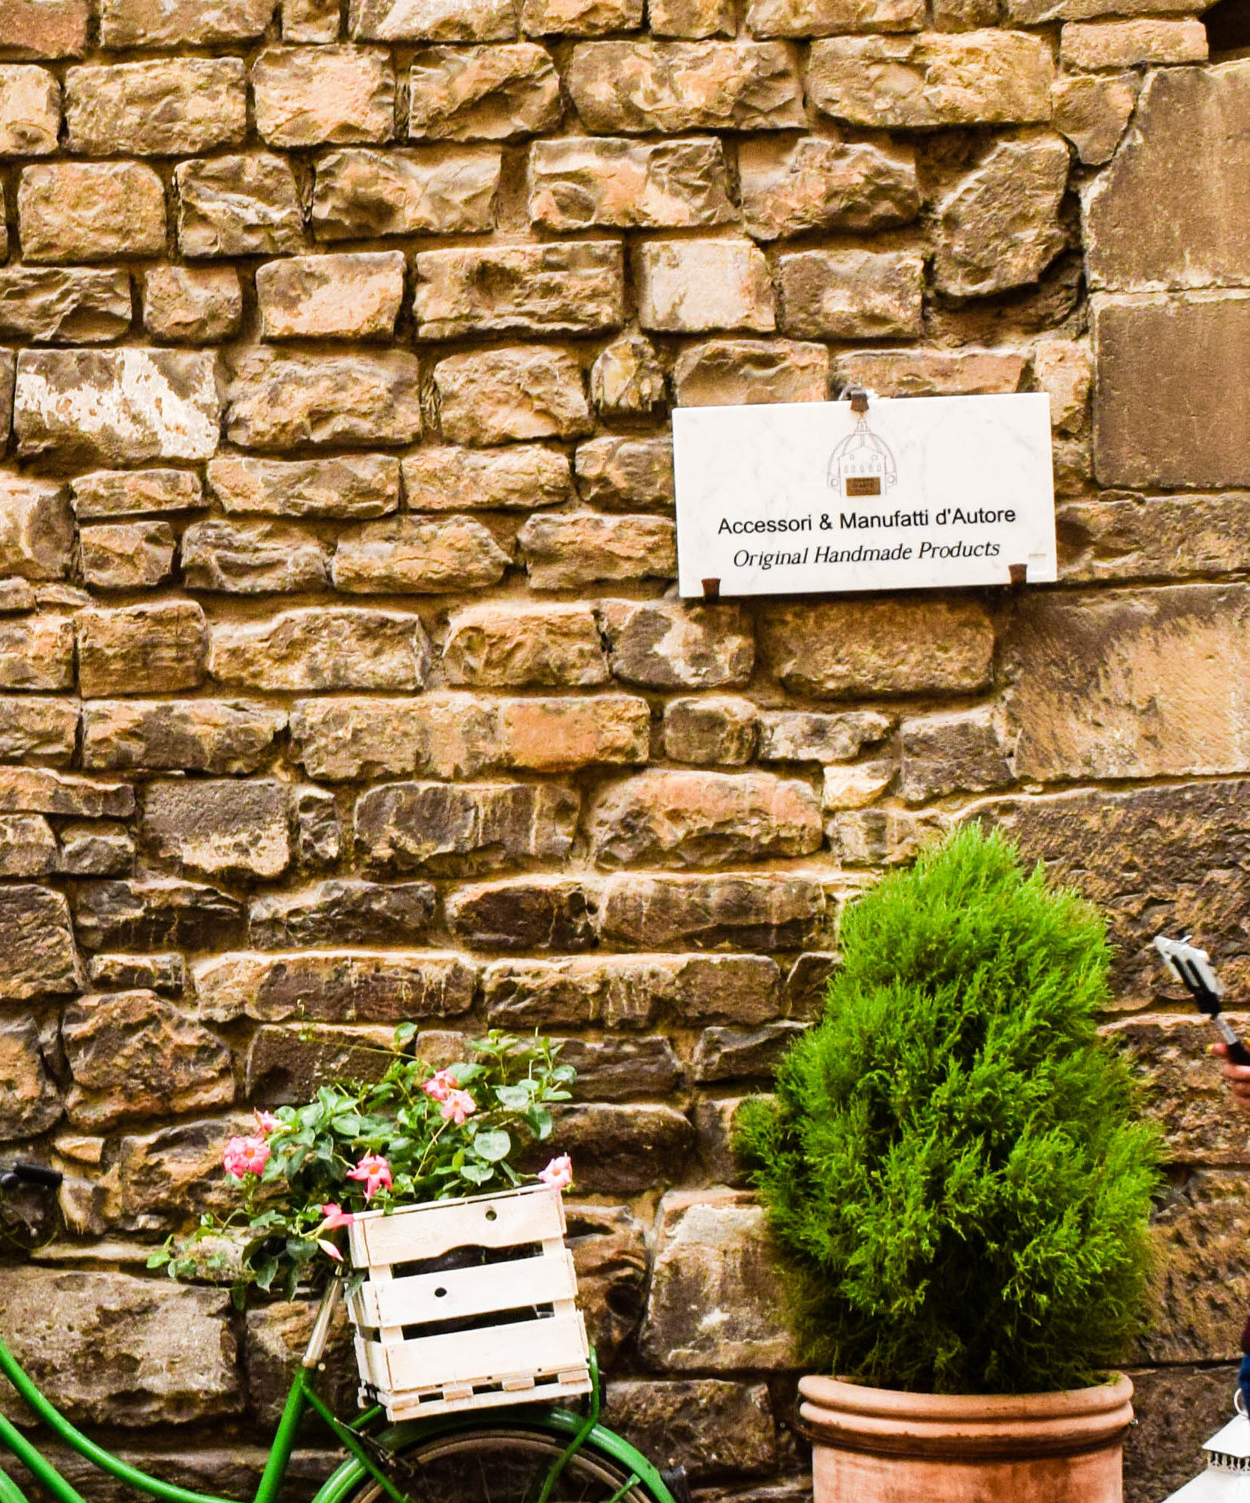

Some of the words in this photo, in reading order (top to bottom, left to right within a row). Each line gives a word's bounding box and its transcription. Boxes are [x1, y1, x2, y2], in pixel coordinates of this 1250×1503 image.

[718, 514, 812, 535] Accessori
[819, 513, 833, 531] &
[839, 509, 929, 530] Manufatti
[935, 507, 1016, 526] d'Autore
[733, 547, 809, 571] Original
[814, 543, 912, 564] Handmade
[918, 540, 1000, 559] Products
